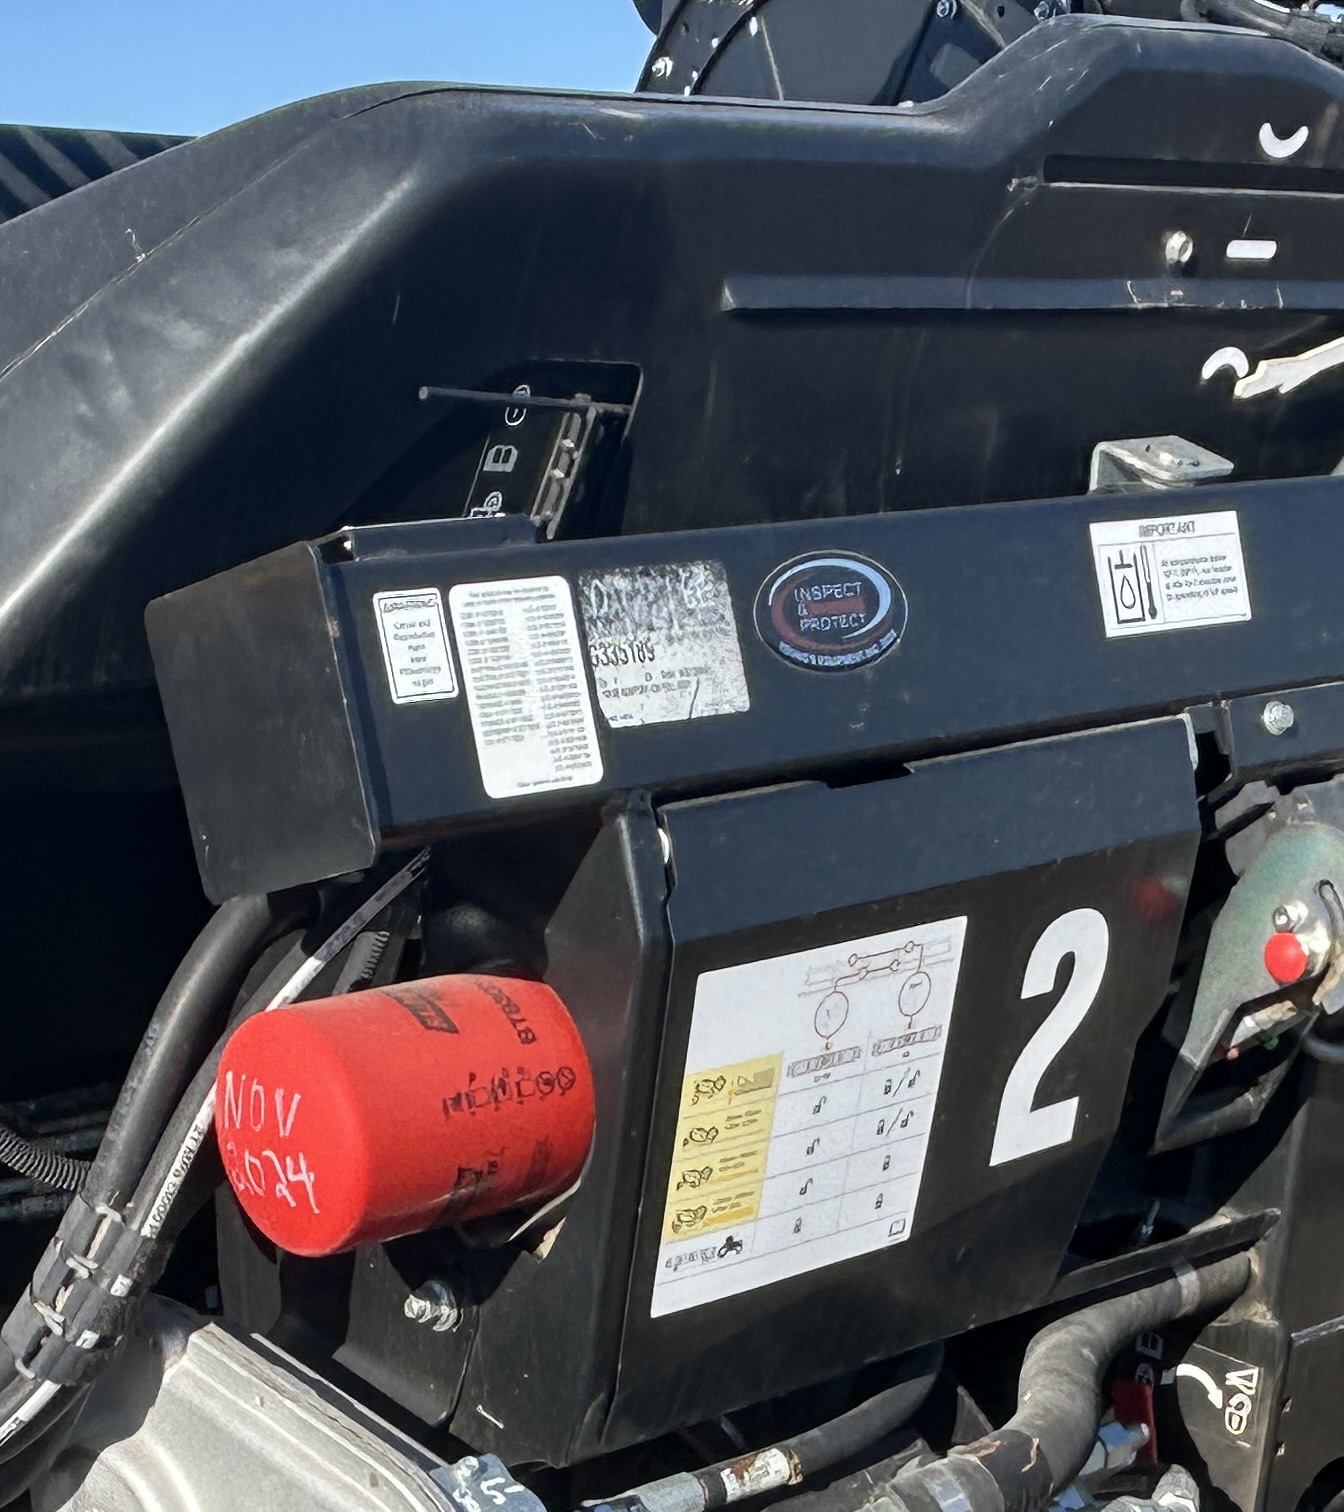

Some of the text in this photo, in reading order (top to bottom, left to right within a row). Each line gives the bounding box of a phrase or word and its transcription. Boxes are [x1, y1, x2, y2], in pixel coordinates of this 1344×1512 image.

[794, 581, 863, 603] INSPECT
[799, 612, 867, 632] PROTECT
[990, 907, 1110, 1167] 2
[223, 1070, 302, 1138] NOV
[226, 1141, 321, 1215] 2024
